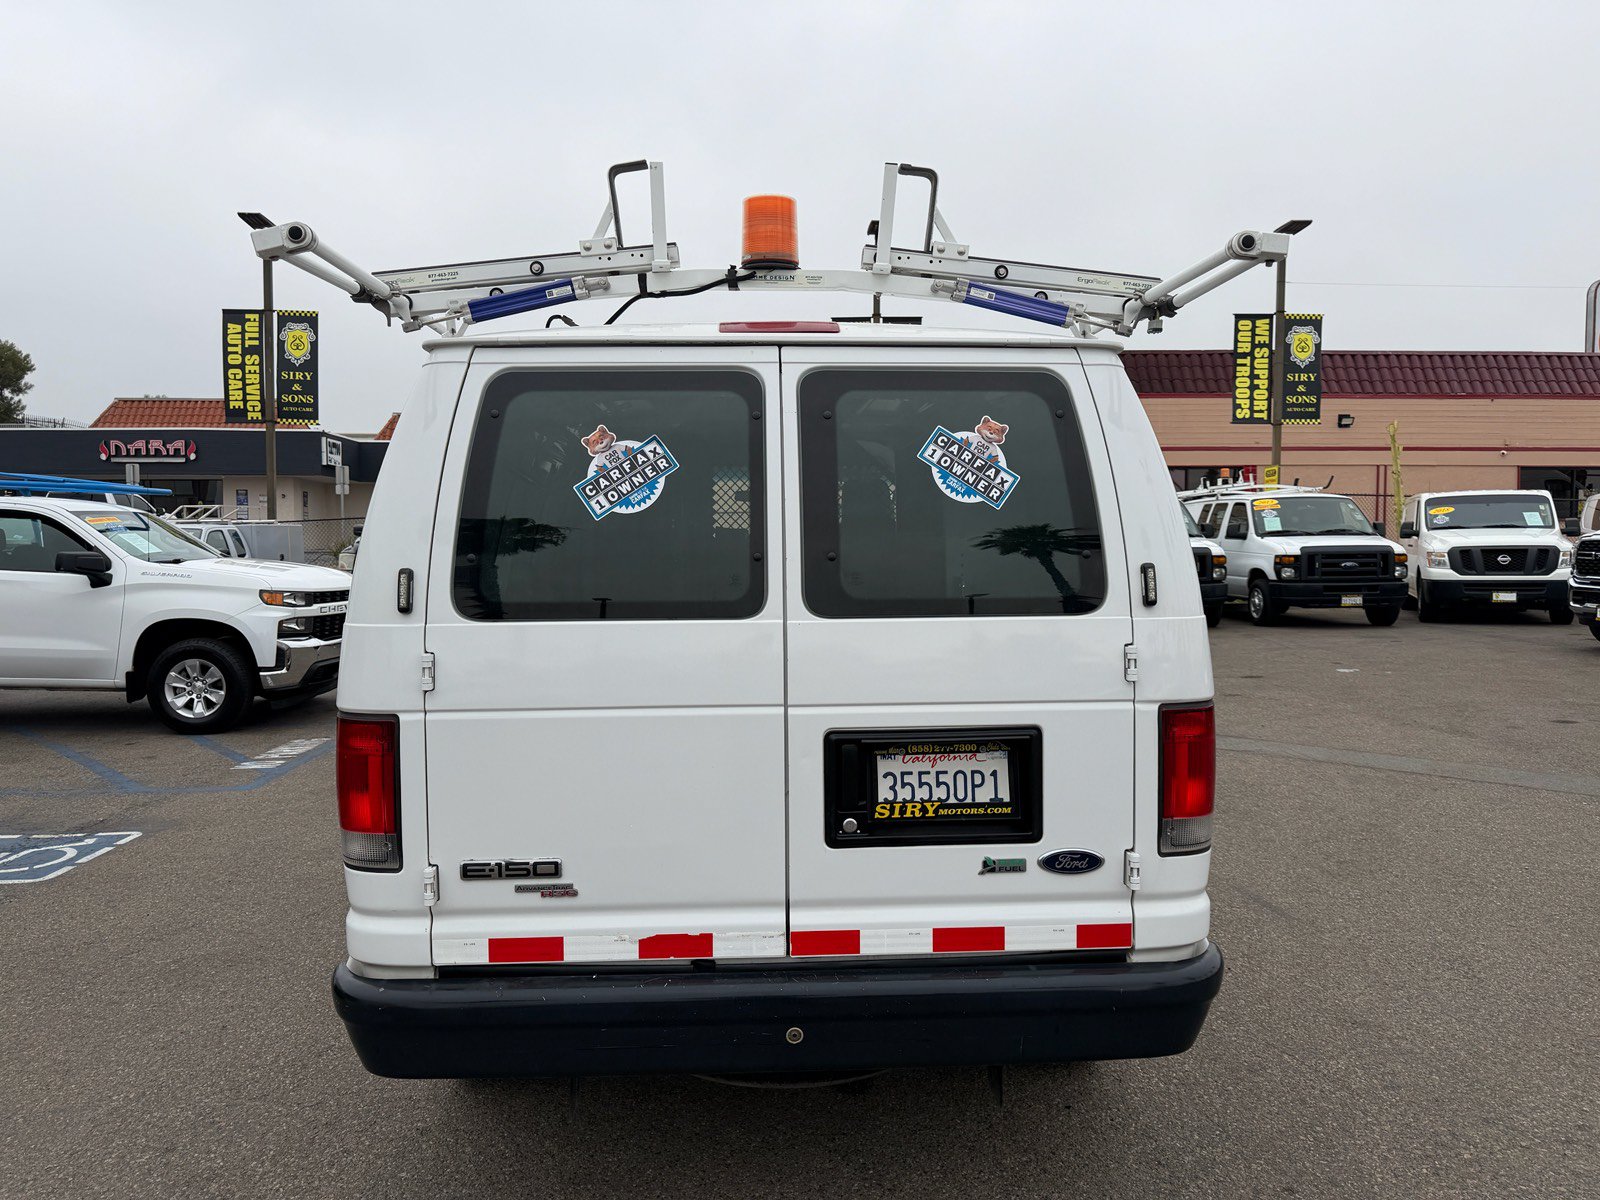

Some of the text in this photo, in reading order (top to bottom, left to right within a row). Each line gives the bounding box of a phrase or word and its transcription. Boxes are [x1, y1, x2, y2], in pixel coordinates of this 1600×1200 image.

[227, 323, 244, 410] AUTO CARE
[245, 313, 262, 420] FULL SERVICE
[1235, 320, 1252, 419] OUR TROOPS
[1253, 318, 1270, 420] WE SUPPORT
[281, 371, 313, 381] SIRY
[1286, 373, 1317, 382] SIRY
[291, 383, 302, 391] &
[281, 394, 314, 404] SONS
[1285, 395, 1317, 404] SONS
[110, 440, 186, 456] NARA
[973, 446, 986, 456] FOX
[976, 440, 990, 452] CAR
[604, 449, 619, 461] CAR
[608, 456, 621, 466] FOX
[937, 436, 1010, 489] CARFAX
[585, 446, 661, 496] CARFAX
[927, 448, 938, 460] 1
[940, 456, 1000, 500] OWNER
[594, 499, 606, 510] 1
[607, 458, 669, 502] OWNER
[141, 571, 192, 579] SILVERADO
[901, 752, 987, 768] California
[882, 769, 1004, 803] 35550P1
[1055, 853, 1089, 869] Ford
[461, 860, 562, 879] E-150
